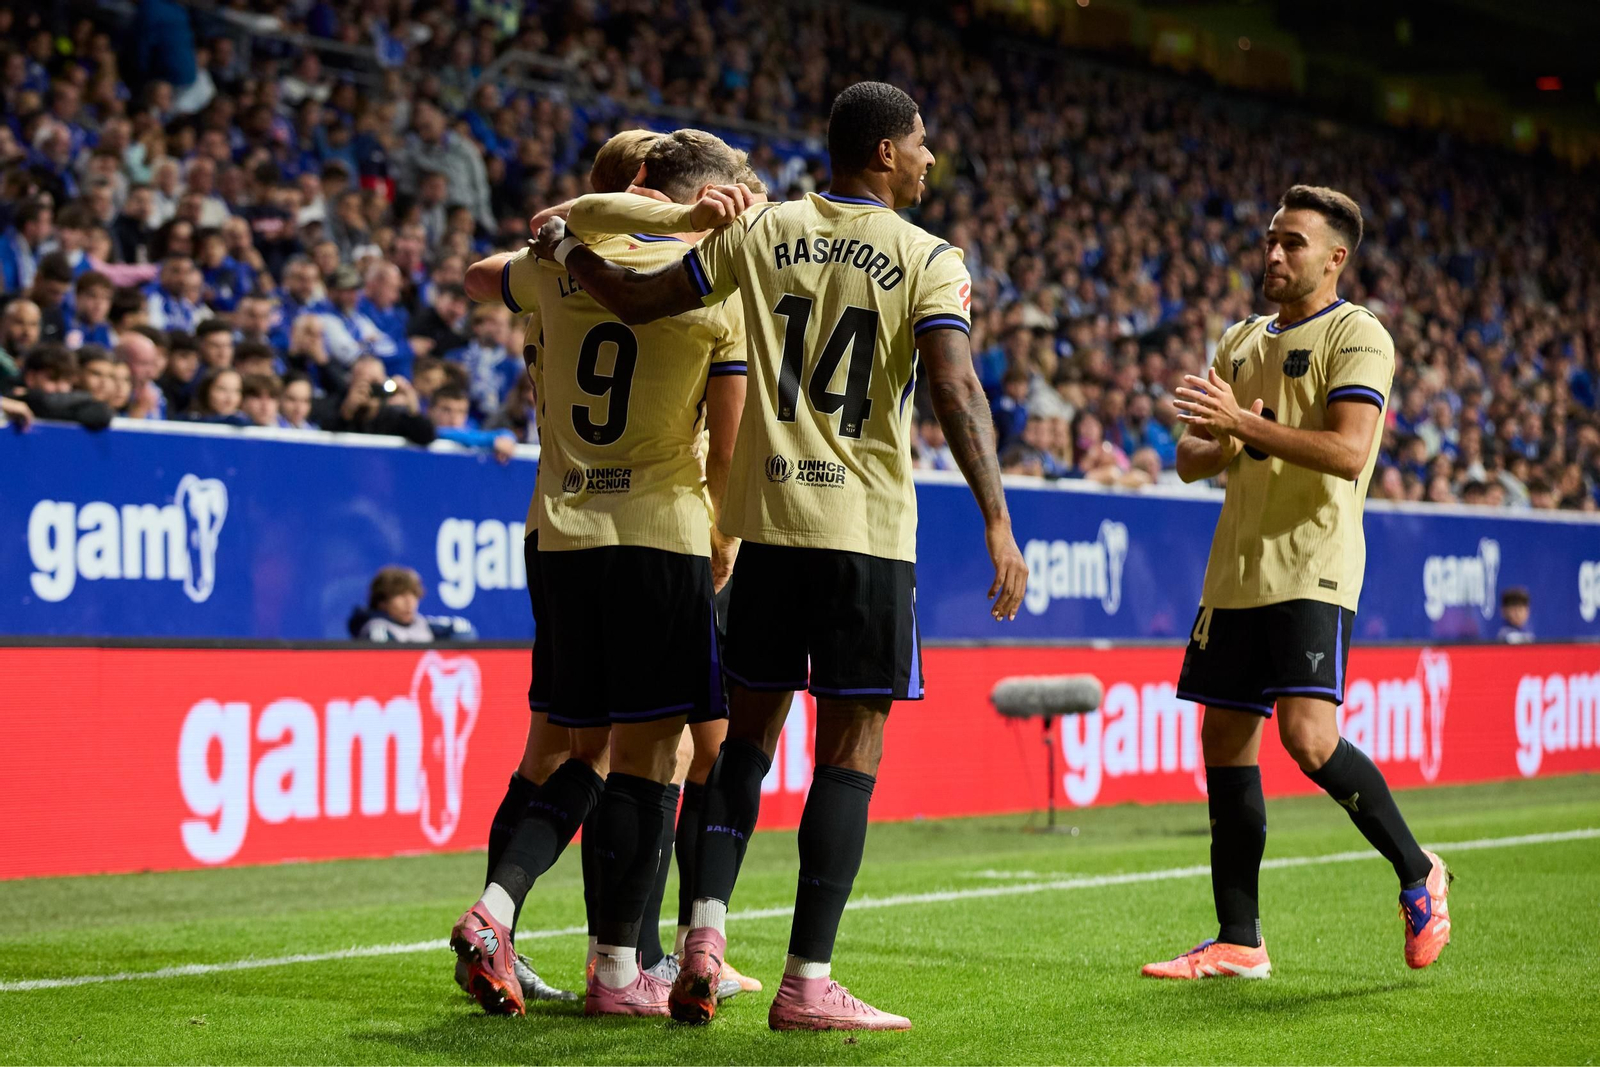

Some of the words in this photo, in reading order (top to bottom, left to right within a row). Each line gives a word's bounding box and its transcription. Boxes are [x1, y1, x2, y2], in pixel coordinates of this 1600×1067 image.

[773, 237, 904, 291] RASHFORD
[571, 320, 638, 446] 9
[772, 293, 879, 440] 14
[1340, 346, 1382, 356] AMBILIGHT
[586, 468, 632, 479] UNHCR
[586, 478, 631, 490] ACNUR
[795, 471, 845, 484] ACNUR
[798, 460, 846, 474] UNHCR
[27, 499, 188, 602] gam
[1023, 538, 1107, 616] gam
[1423, 555, 1485, 621] gam
[1336, 677, 1423, 763] am
[178, 697, 423, 865] gam
